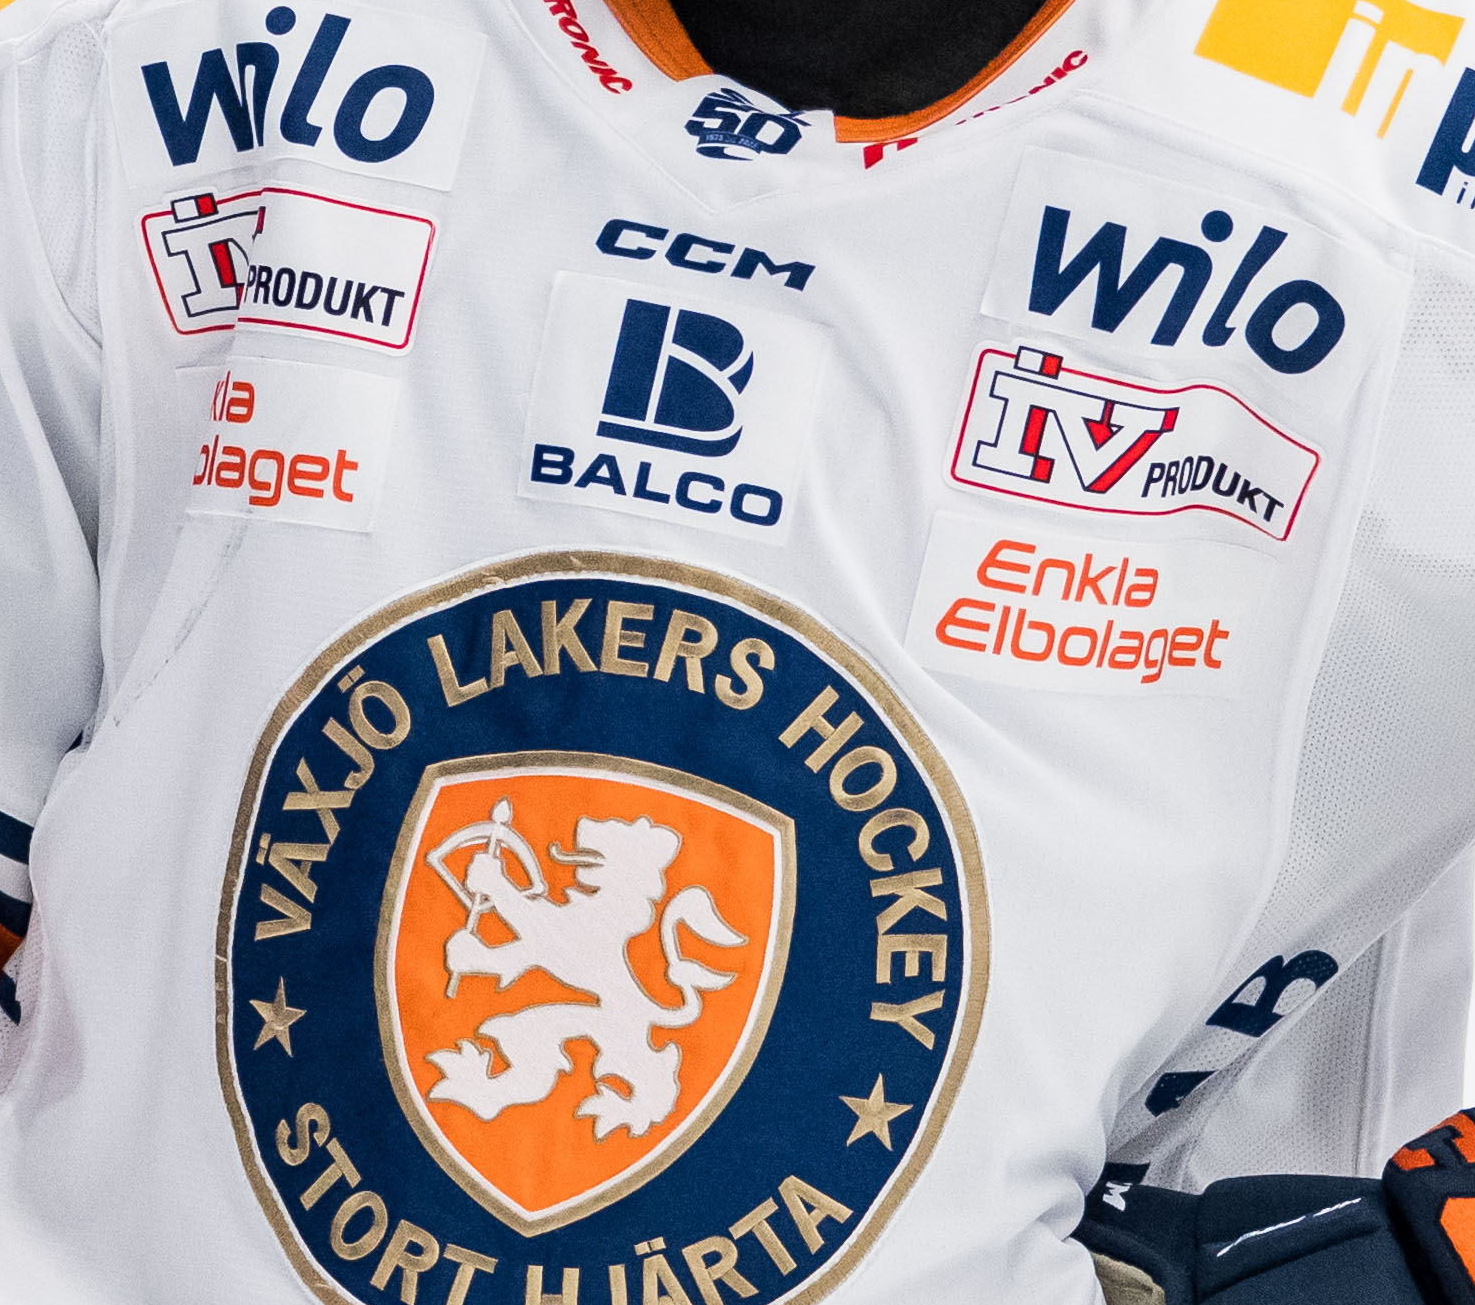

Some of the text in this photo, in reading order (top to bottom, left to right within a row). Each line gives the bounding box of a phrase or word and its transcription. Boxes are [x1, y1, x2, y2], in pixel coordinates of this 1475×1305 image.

[140, 5, 436, 168] wilo
[246, 259, 406, 329] PRODUKT
[595, 218, 816, 292] CCM
[1028, 204, 1346, 375] wilo
[530, 443, 783, 527] BALCO
[1140, 454, 1285, 523] PRODUKT
[975, 538, 1160, 608] Enkla
[934, 596, 1231, 685] Elbolaget
[253, 665, 412, 943] VÄXJÖ
[426, 597, 776, 711] LAKERS
[777, 687, 950, 1052] HOCKEY
